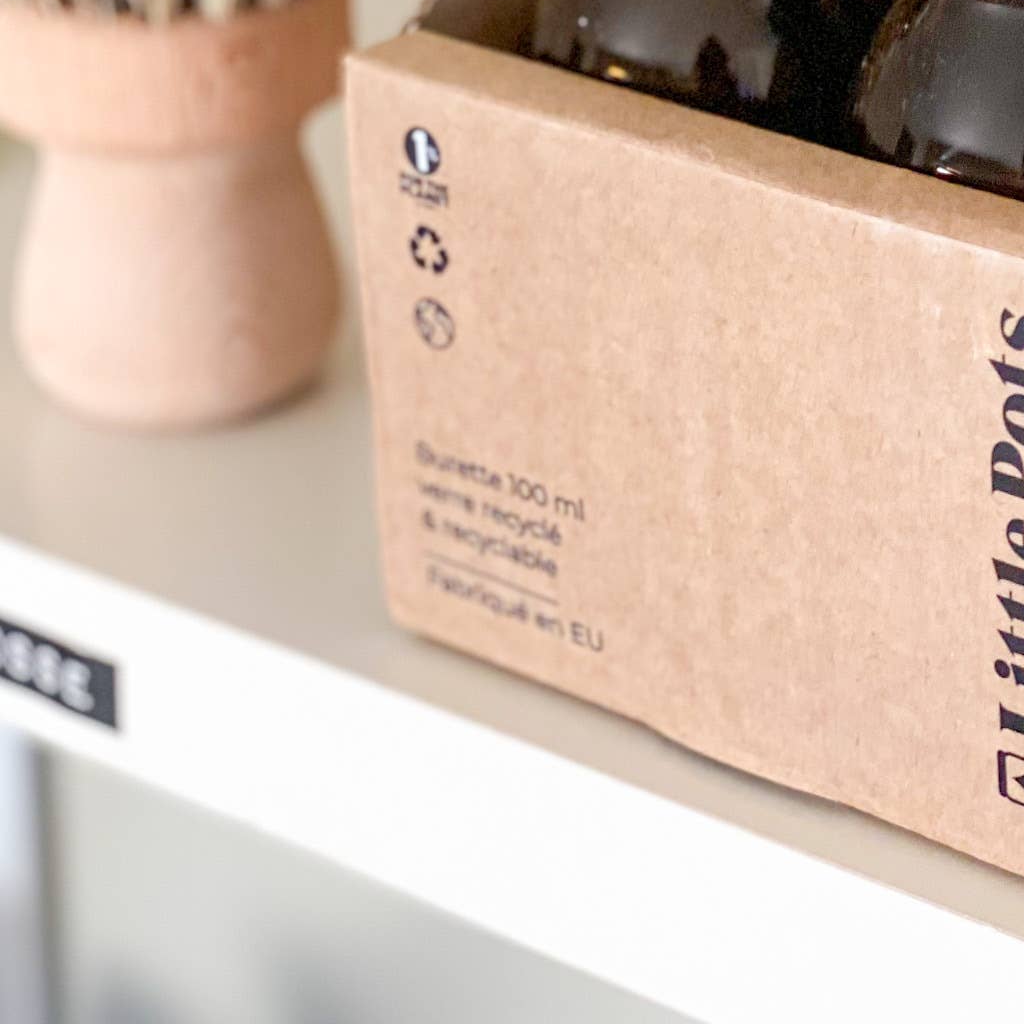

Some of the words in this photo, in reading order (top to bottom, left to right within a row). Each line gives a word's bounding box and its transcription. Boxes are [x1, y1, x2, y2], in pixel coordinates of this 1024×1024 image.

[415, 440, 501, 490] Burette
[508, 473, 548, 507] 100
[554, 495, 585, 522] ml
[442, 519, 559, 578] recyclable
[427, 564, 528, 621] Fabriqué
[535, 612, 565, 637] en
[570, 621, 604, 653] EU
